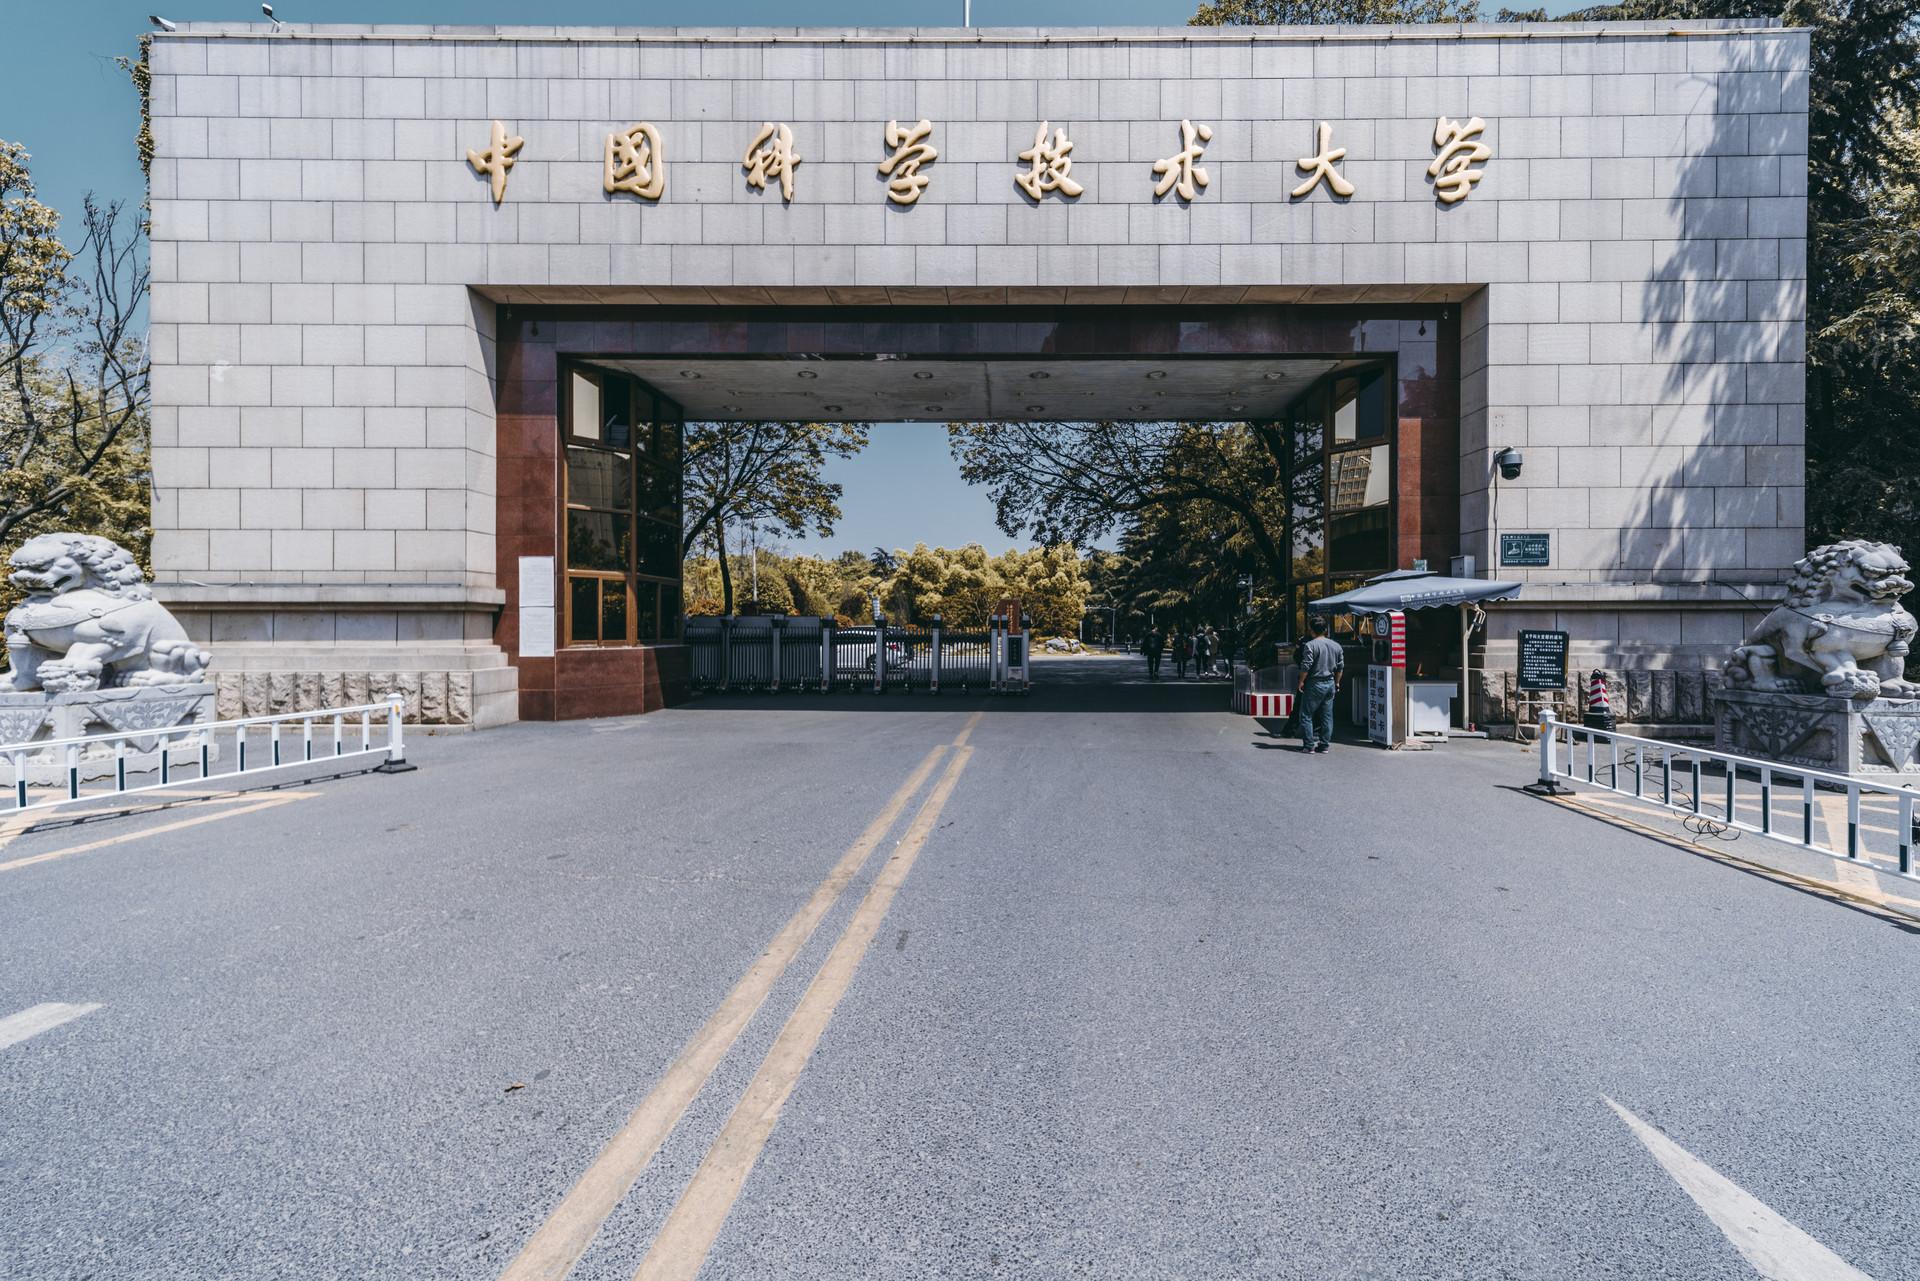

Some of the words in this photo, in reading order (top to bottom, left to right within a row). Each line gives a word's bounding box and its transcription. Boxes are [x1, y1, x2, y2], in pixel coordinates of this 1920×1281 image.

[467, 118, 1491, 207] 中国科学技术大学
